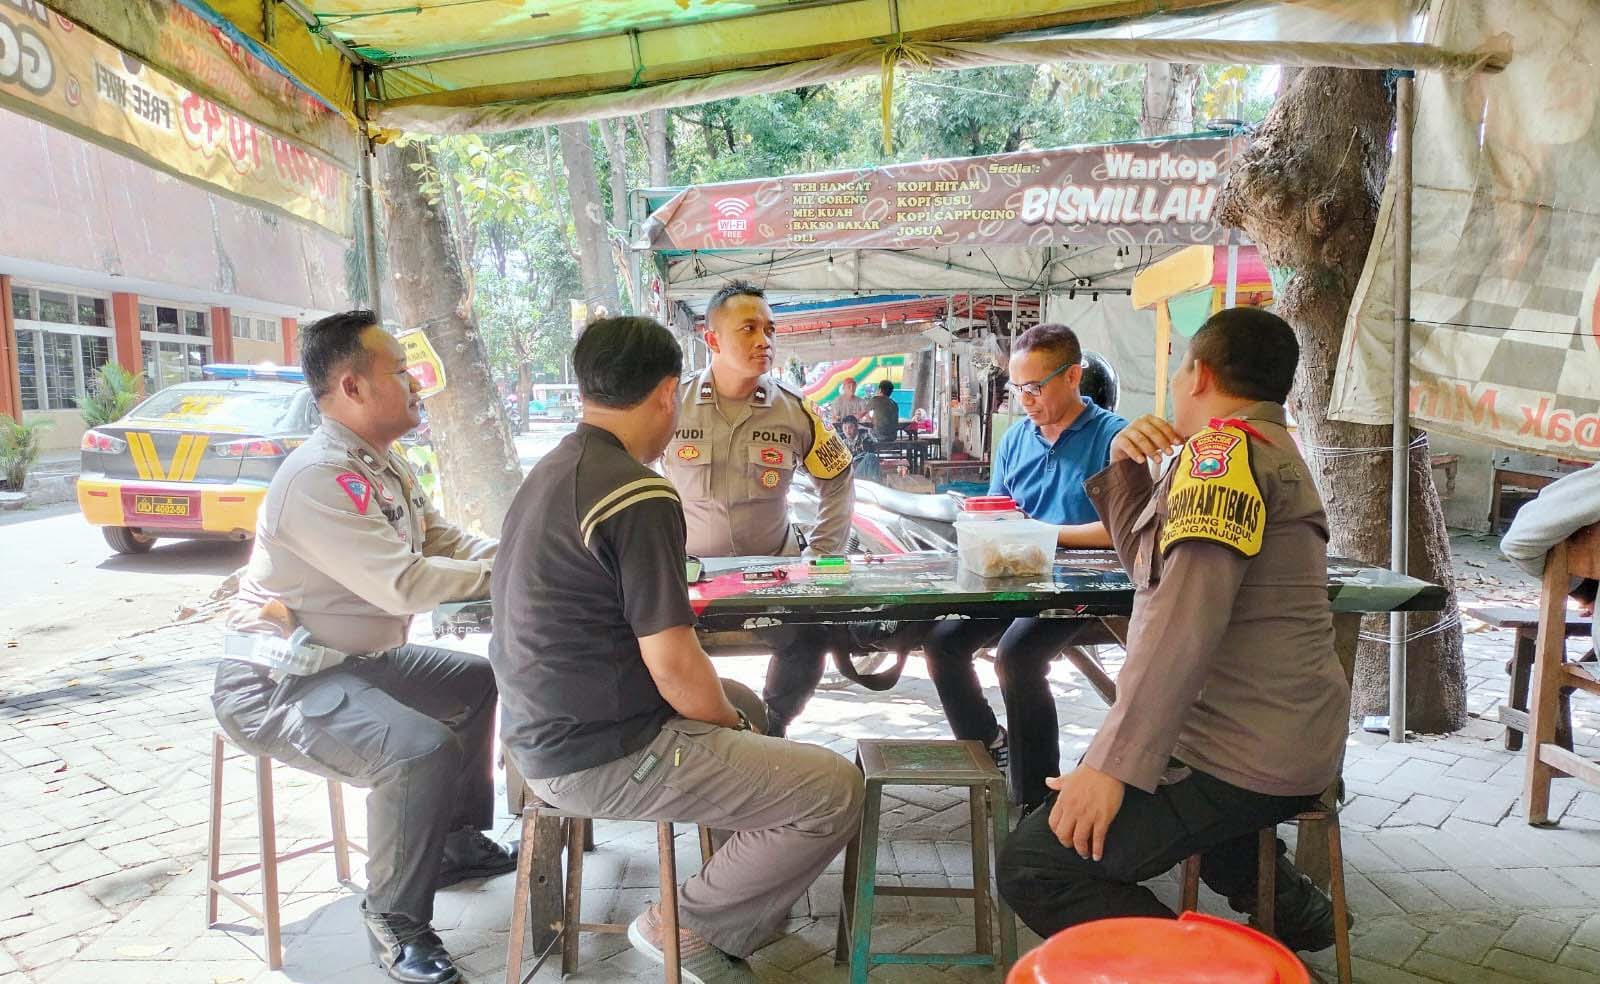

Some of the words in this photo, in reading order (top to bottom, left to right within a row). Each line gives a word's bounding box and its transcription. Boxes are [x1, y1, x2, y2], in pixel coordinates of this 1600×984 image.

[1104, 152, 1217, 184] Warkop
[792, 182, 817, 192] TEH
[819, 182, 872, 192] HANGAT
[896, 181, 932, 192] KOPI
[934, 180, 981, 192] HITAM
[792, 195, 816, 205] MIE
[818, 195, 868, 205] GORENG
[896, 196, 931, 208] KOPI
[933, 195, 973, 206] SUSU
[1021, 184, 1217, 225] BISMILLAH
[792, 208, 816, 218] MIE
[817, 208, 853, 217] KUAH
[896, 211, 930, 222] KOPI
[934, 209, 1016, 221] CAPPUCINO
[792, 220, 834, 230] BAKSO
[837, 220, 880, 230] BAKAR
[896, 225, 944, 237] JOSUA
[793, 233, 816, 242] DLL
[752, 430, 792, 445] POLRI
[1182, 525, 1240, 545] NGANJUK
[1224, 522, 1252, 542] KIDUL
